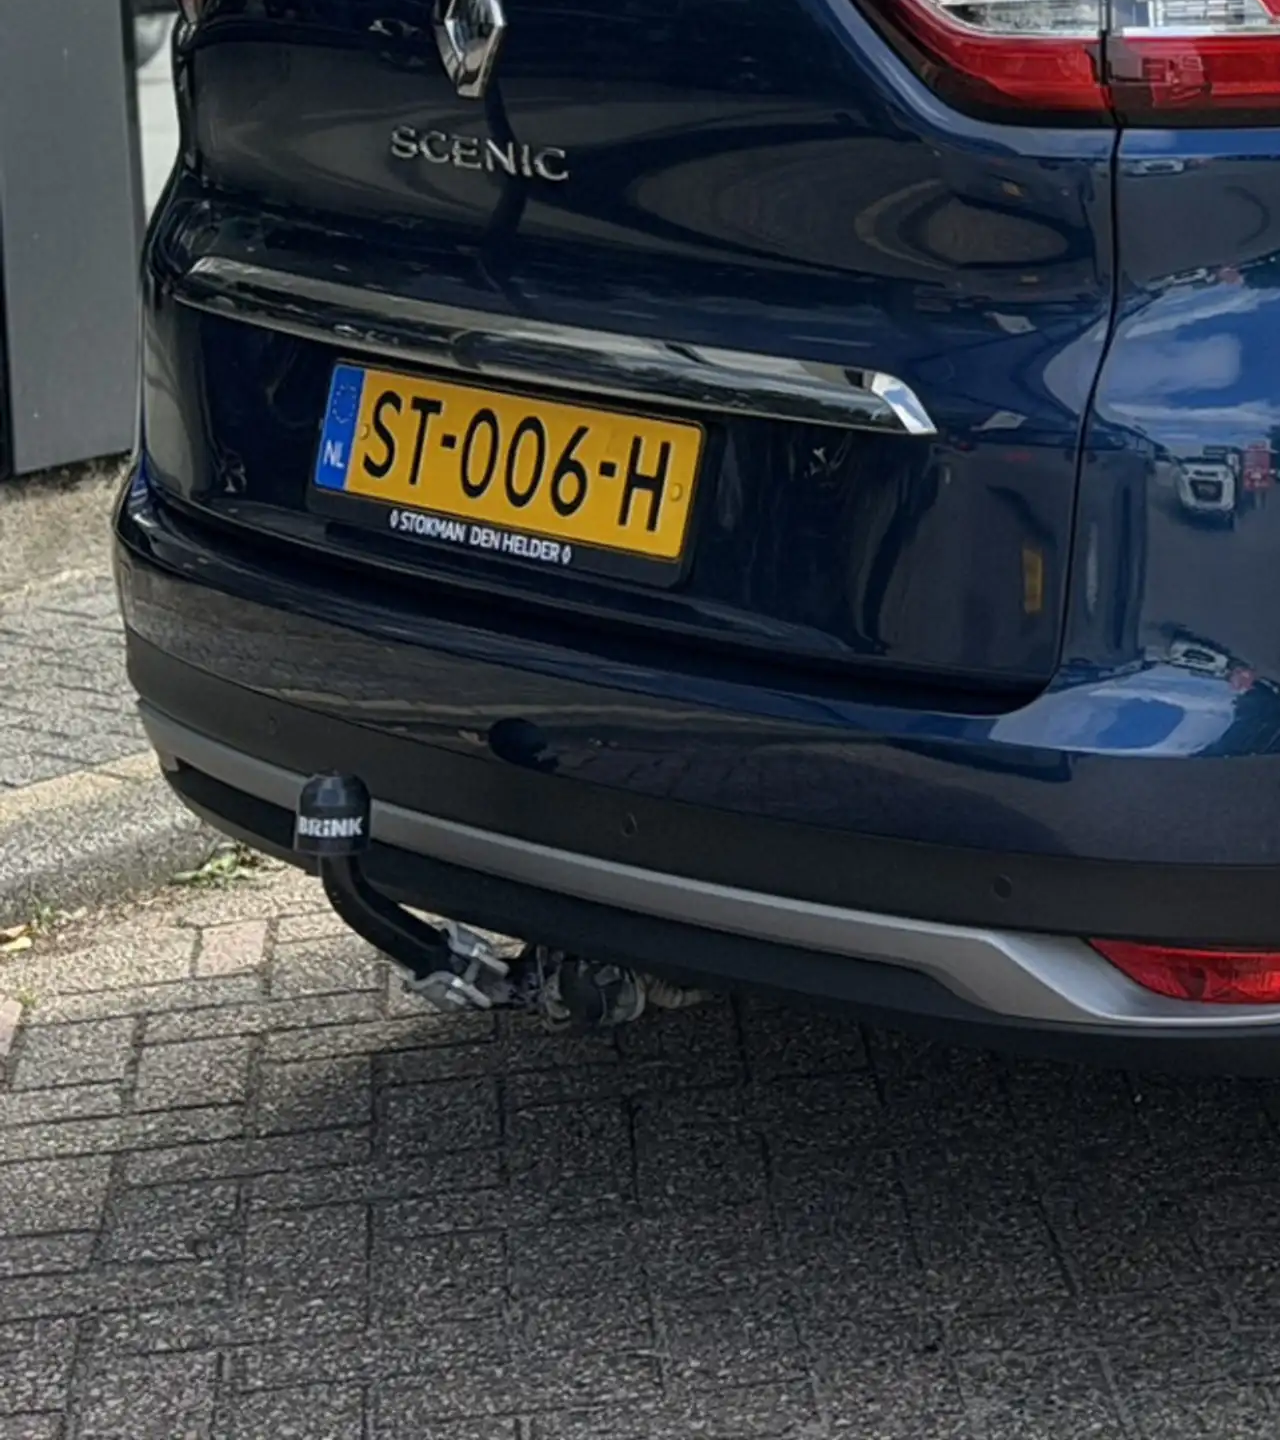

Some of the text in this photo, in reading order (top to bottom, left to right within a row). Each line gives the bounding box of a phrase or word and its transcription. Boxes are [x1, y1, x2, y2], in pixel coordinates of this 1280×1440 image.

[391, 125, 570, 181] SCENIC
[323, 439, 345, 469] NL
[363, 390, 671, 532] ST-006-H
[400, 511, 561, 564] STOKMAN DEN HELDER
